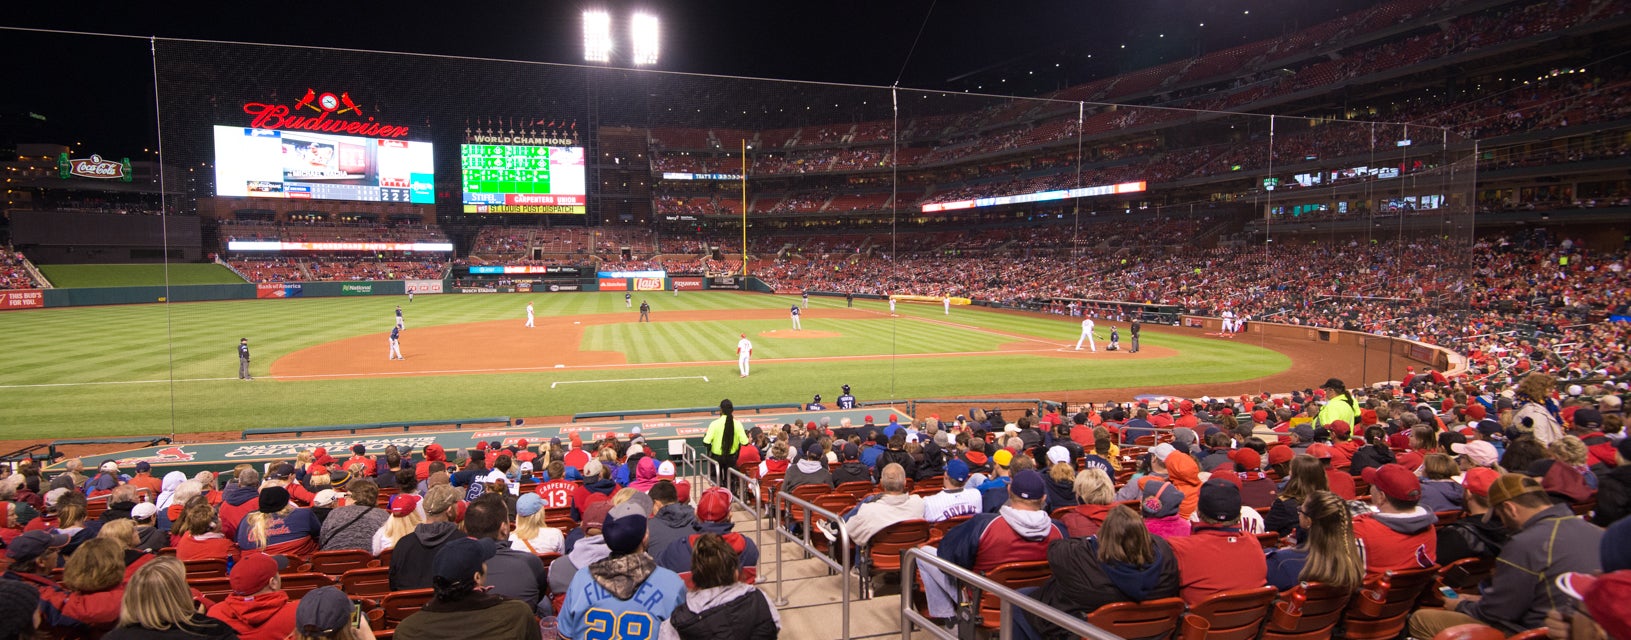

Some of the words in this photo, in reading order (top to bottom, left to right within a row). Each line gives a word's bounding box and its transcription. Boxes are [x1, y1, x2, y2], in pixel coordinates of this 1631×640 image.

[243, 102, 409, 138] Budweiser
[474, 135, 511, 143] WORLD
[513, 136, 572, 145] CHAMPIONS
[382, 192, 389, 201] 2
[392, 193, 399, 201] 2
[403, 193, 410, 202] 2
[514, 196, 554, 204] CARPENTERS
[501, 205, 521, 213] LOUIS
[842, 401, 852, 410] 31
[234, 439, 347, 452] NATIONAL
[351, 436, 438, 446] LEAGUE
[540, 482, 575, 496] CARPENTER
[547, 489, 568, 508] 13
[943, 504, 977, 520] BRYANT
[584, 580, 664, 611] FIEER
[585, 607, 653, 640] 28
